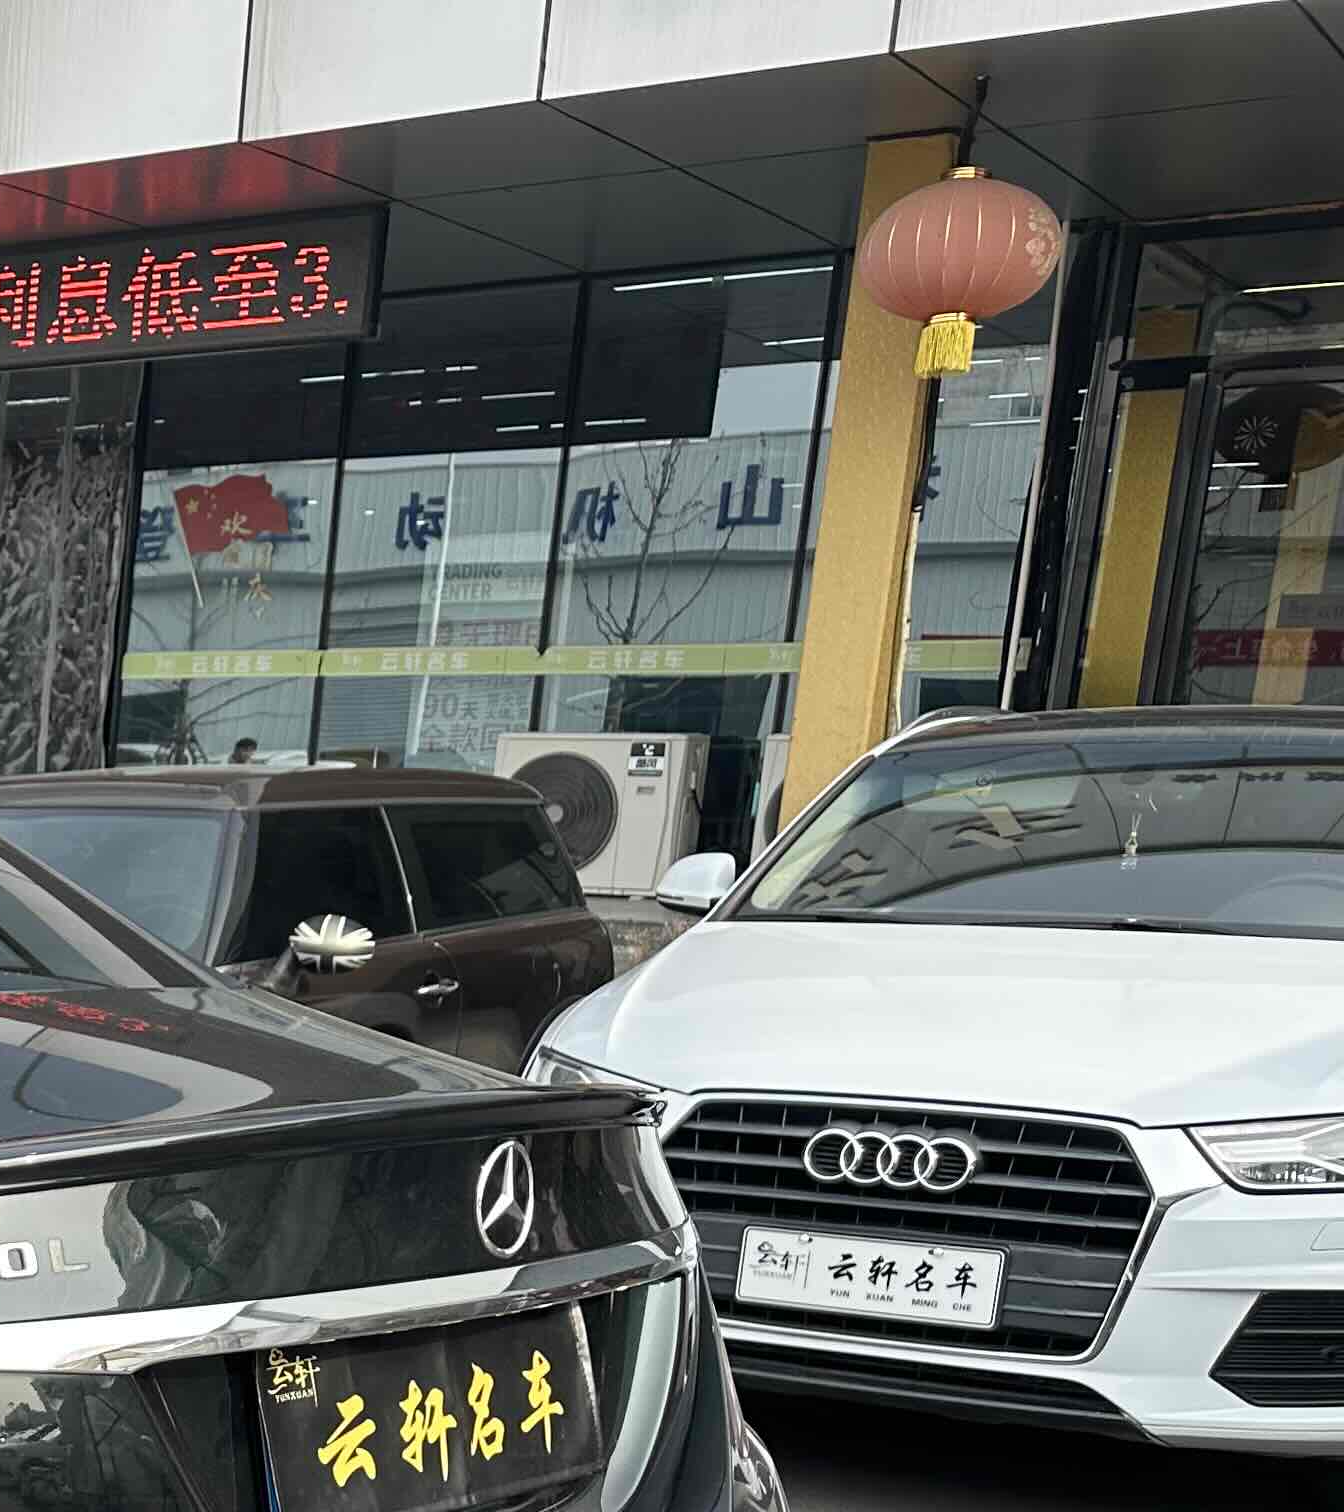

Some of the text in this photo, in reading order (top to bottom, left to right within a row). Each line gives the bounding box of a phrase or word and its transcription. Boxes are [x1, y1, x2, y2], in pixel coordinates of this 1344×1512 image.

[827, 1253, 978, 1299] 云轩名车
[317, 1350, 564, 1488] 云轩名车
